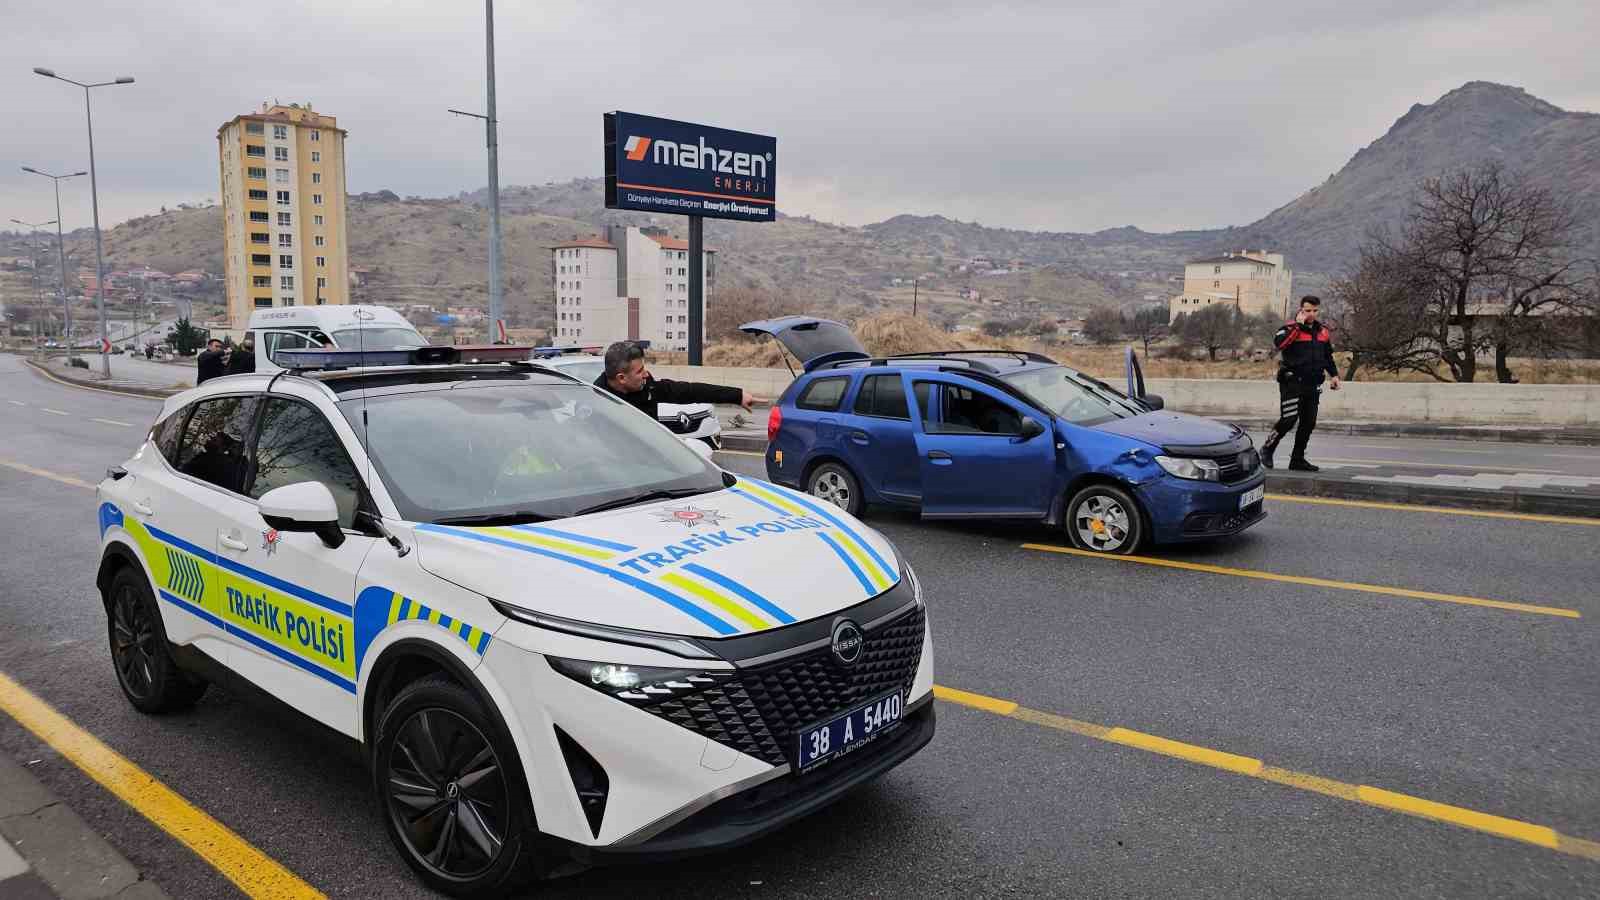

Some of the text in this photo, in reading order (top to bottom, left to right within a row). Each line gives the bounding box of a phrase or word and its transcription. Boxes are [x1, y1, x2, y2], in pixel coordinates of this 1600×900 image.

[653, 136, 766, 179] mahzen
[714, 176, 767, 193] ENERJİ
[618, 516, 831, 574] TRAFİK POLİSİ
[226, 586, 345, 662] TRAFİK POLİSİ
[809, 694, 900, 759] 38 A 5440
